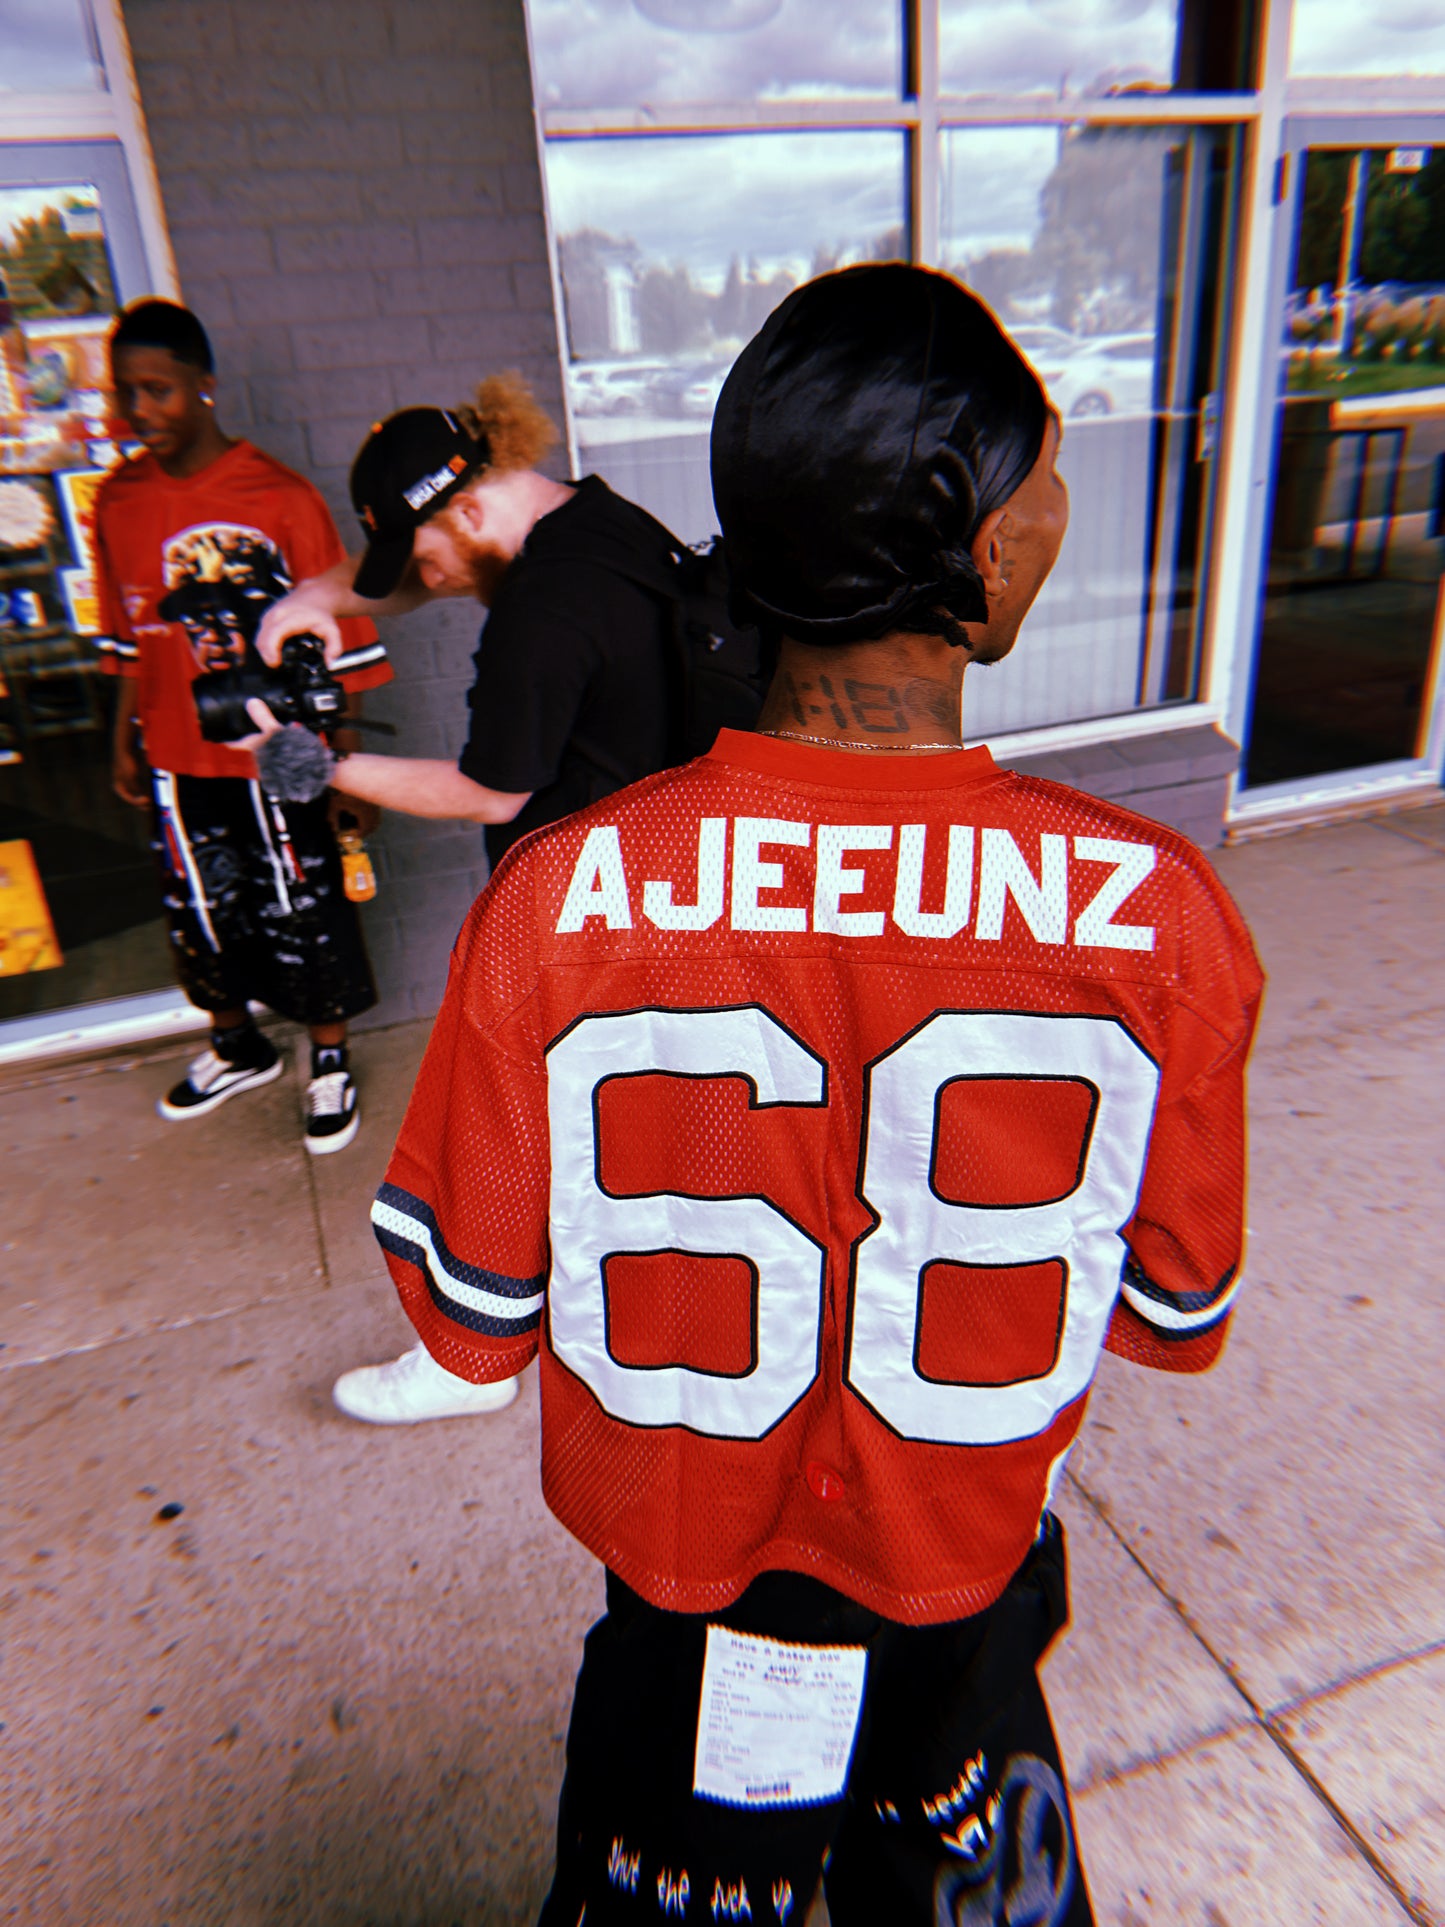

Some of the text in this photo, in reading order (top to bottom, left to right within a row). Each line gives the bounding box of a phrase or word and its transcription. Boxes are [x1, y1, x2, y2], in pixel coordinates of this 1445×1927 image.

[555, 816, 1158, 952] AJEEUNZ
[544, 1002, 1162, 1448] 68
[656, 1866, 691, 1919] the
[710, 1875, 752, 1923] fuck
